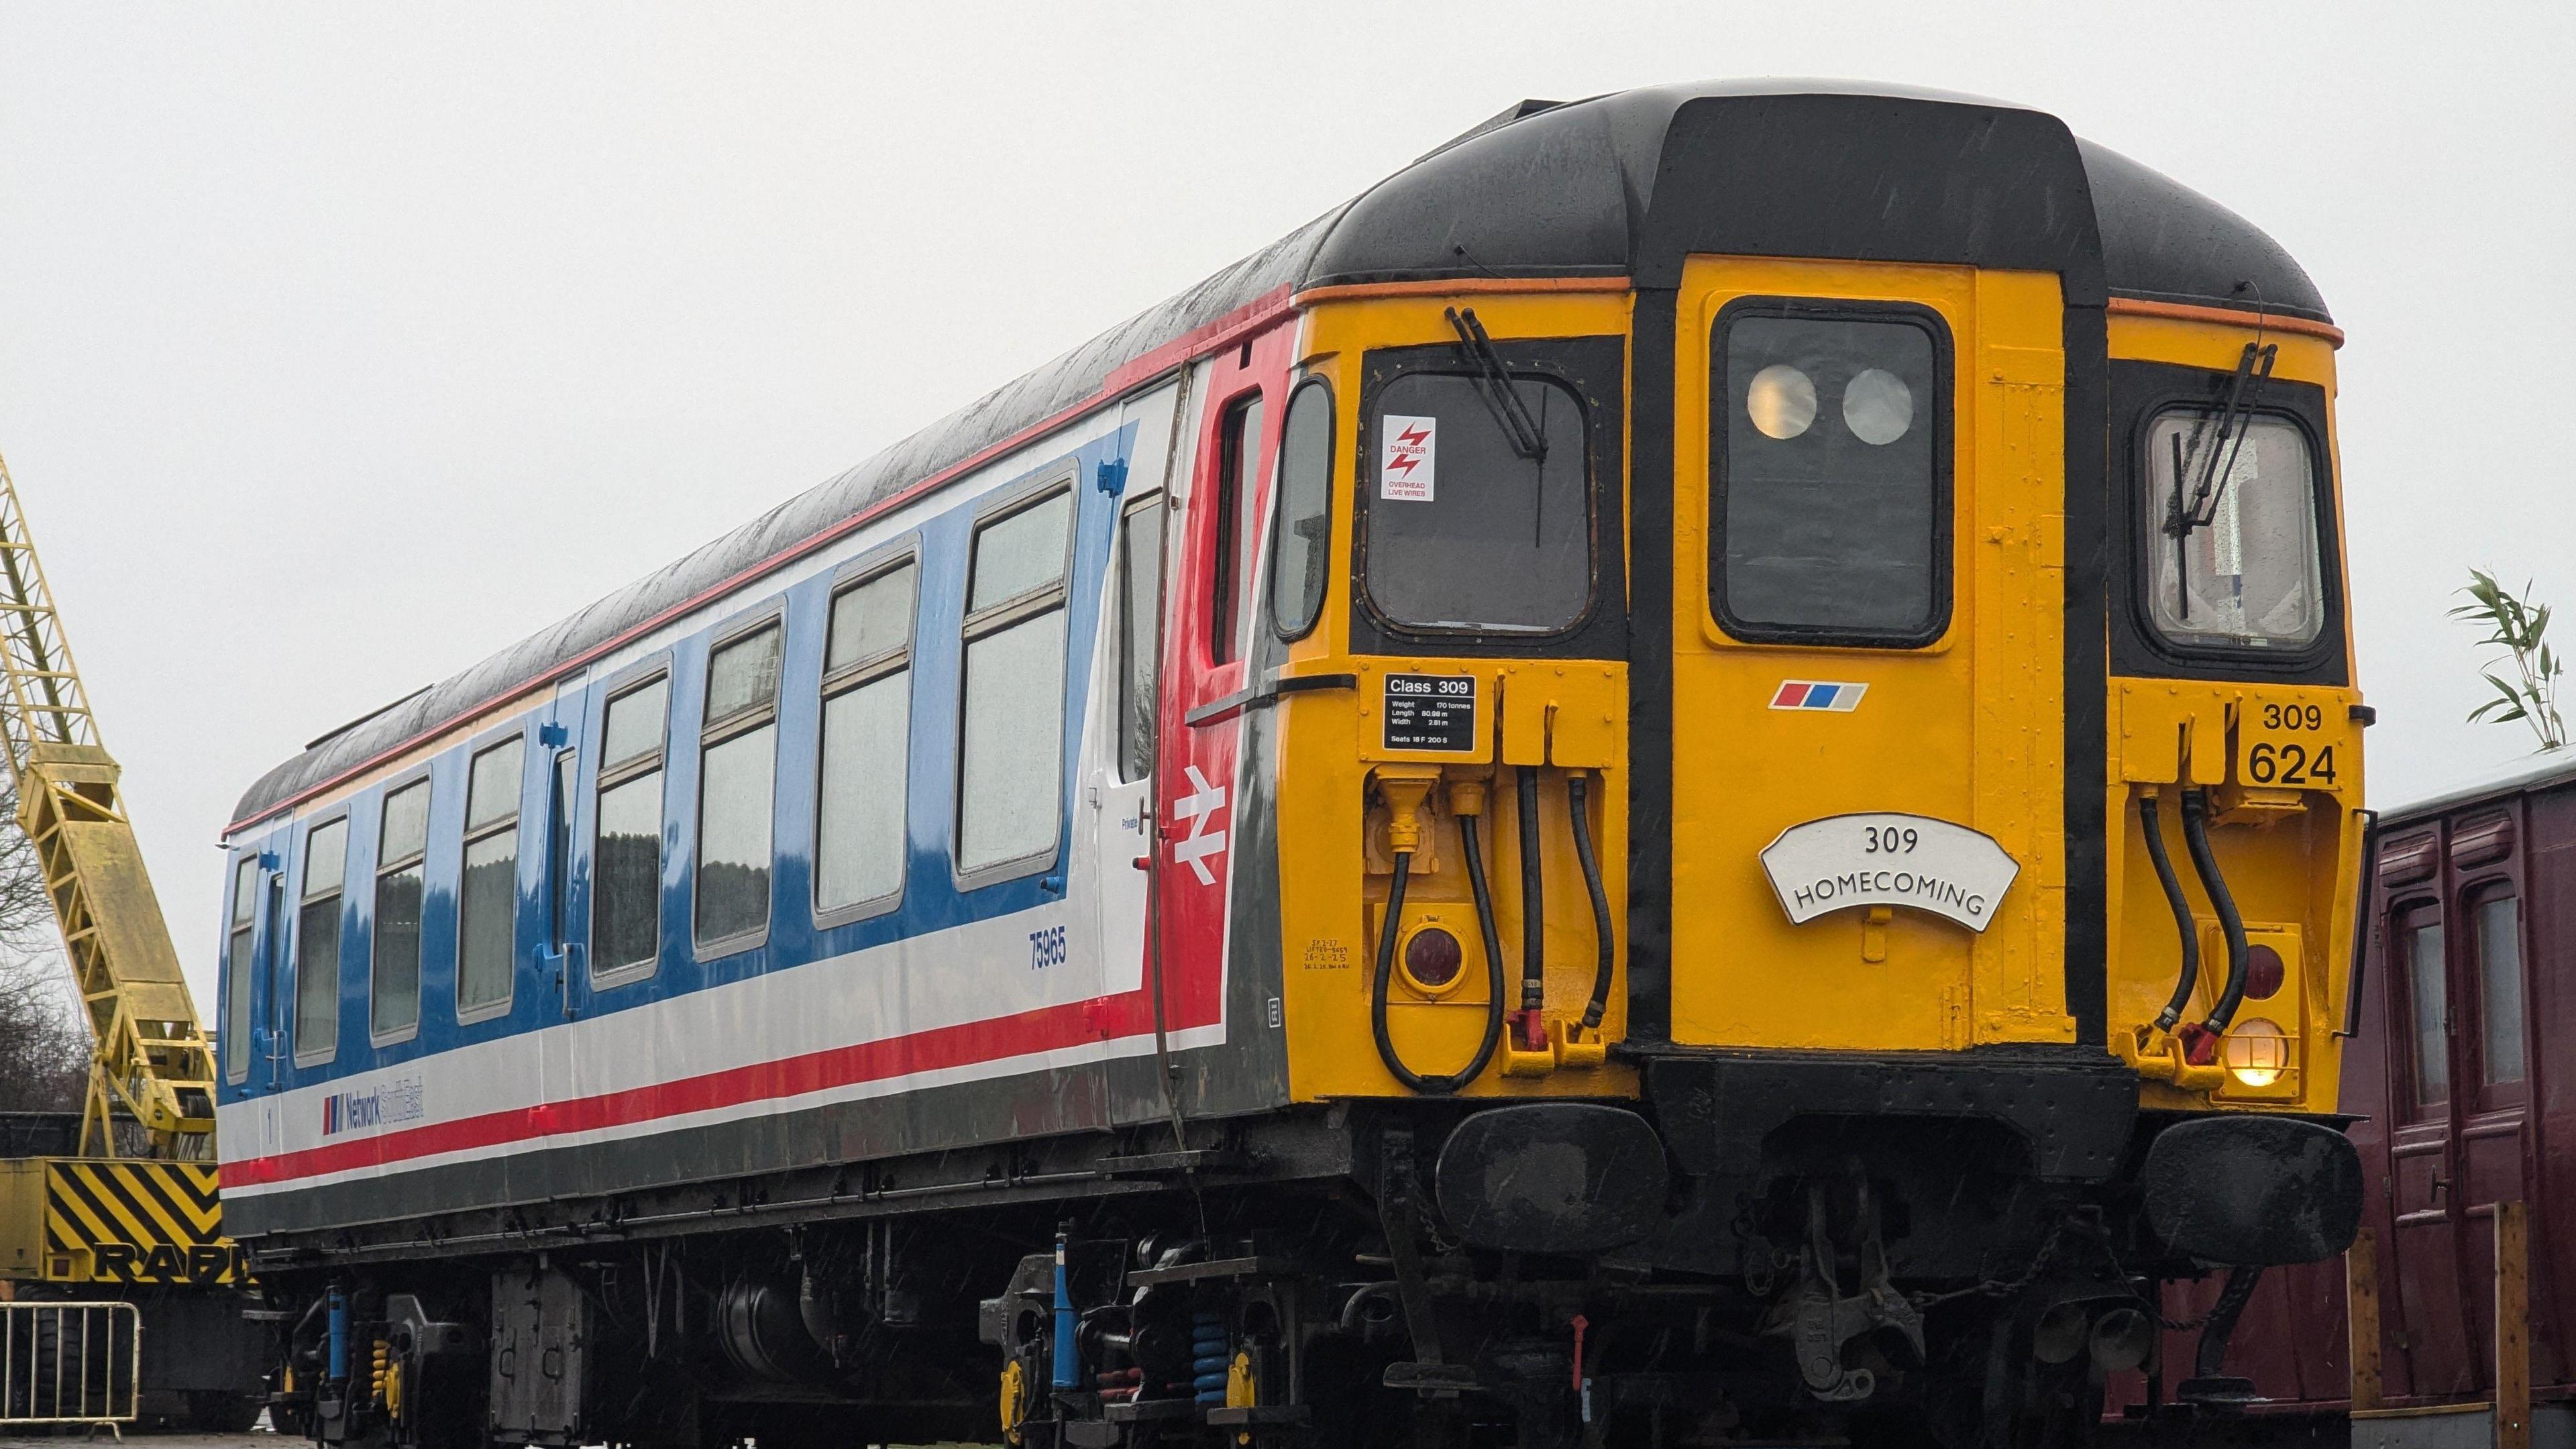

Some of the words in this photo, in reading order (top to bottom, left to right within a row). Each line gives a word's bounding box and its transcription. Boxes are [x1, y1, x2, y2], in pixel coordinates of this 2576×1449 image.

[1390, 445, 1426, 454] DANGER
[1389, 481, 1426, 489] OVERHEAD
[1390, 680, 1432, 693] Class
[1438, 681, 1468, 694] 309
[2263, 704, 2321, 731] 309
[2249, 743, 2336, 785] 624
[1122, 816, 1137, 830] Private
[1866, 826, 1918, 853] 309
[1794, 871, 1985, 915] HOMECOMING
[1030, 926, 1066, 970] 75965
[346, 1087, 381, 1130] Network
